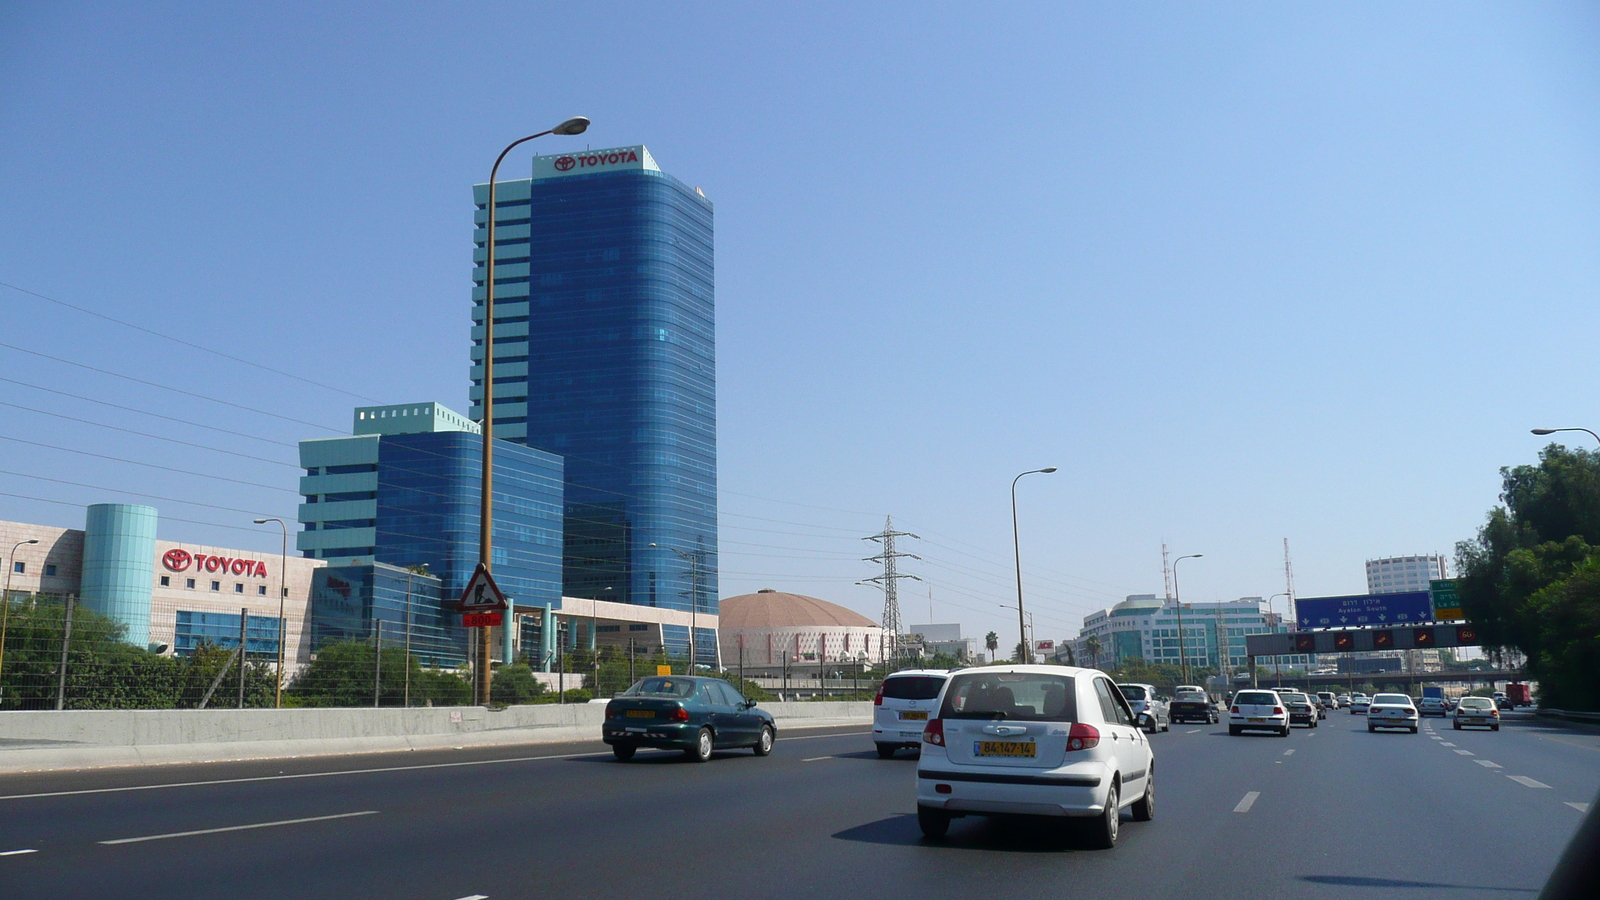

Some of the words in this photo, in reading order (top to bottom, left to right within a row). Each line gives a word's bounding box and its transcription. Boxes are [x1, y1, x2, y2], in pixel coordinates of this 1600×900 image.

[578, 151, 638, 168] TOYOTA
[194, 554, 267, 578] TOYOTA
[1363, 598, 1380, 606] אילון
[471, 615, 491, 625] 800
